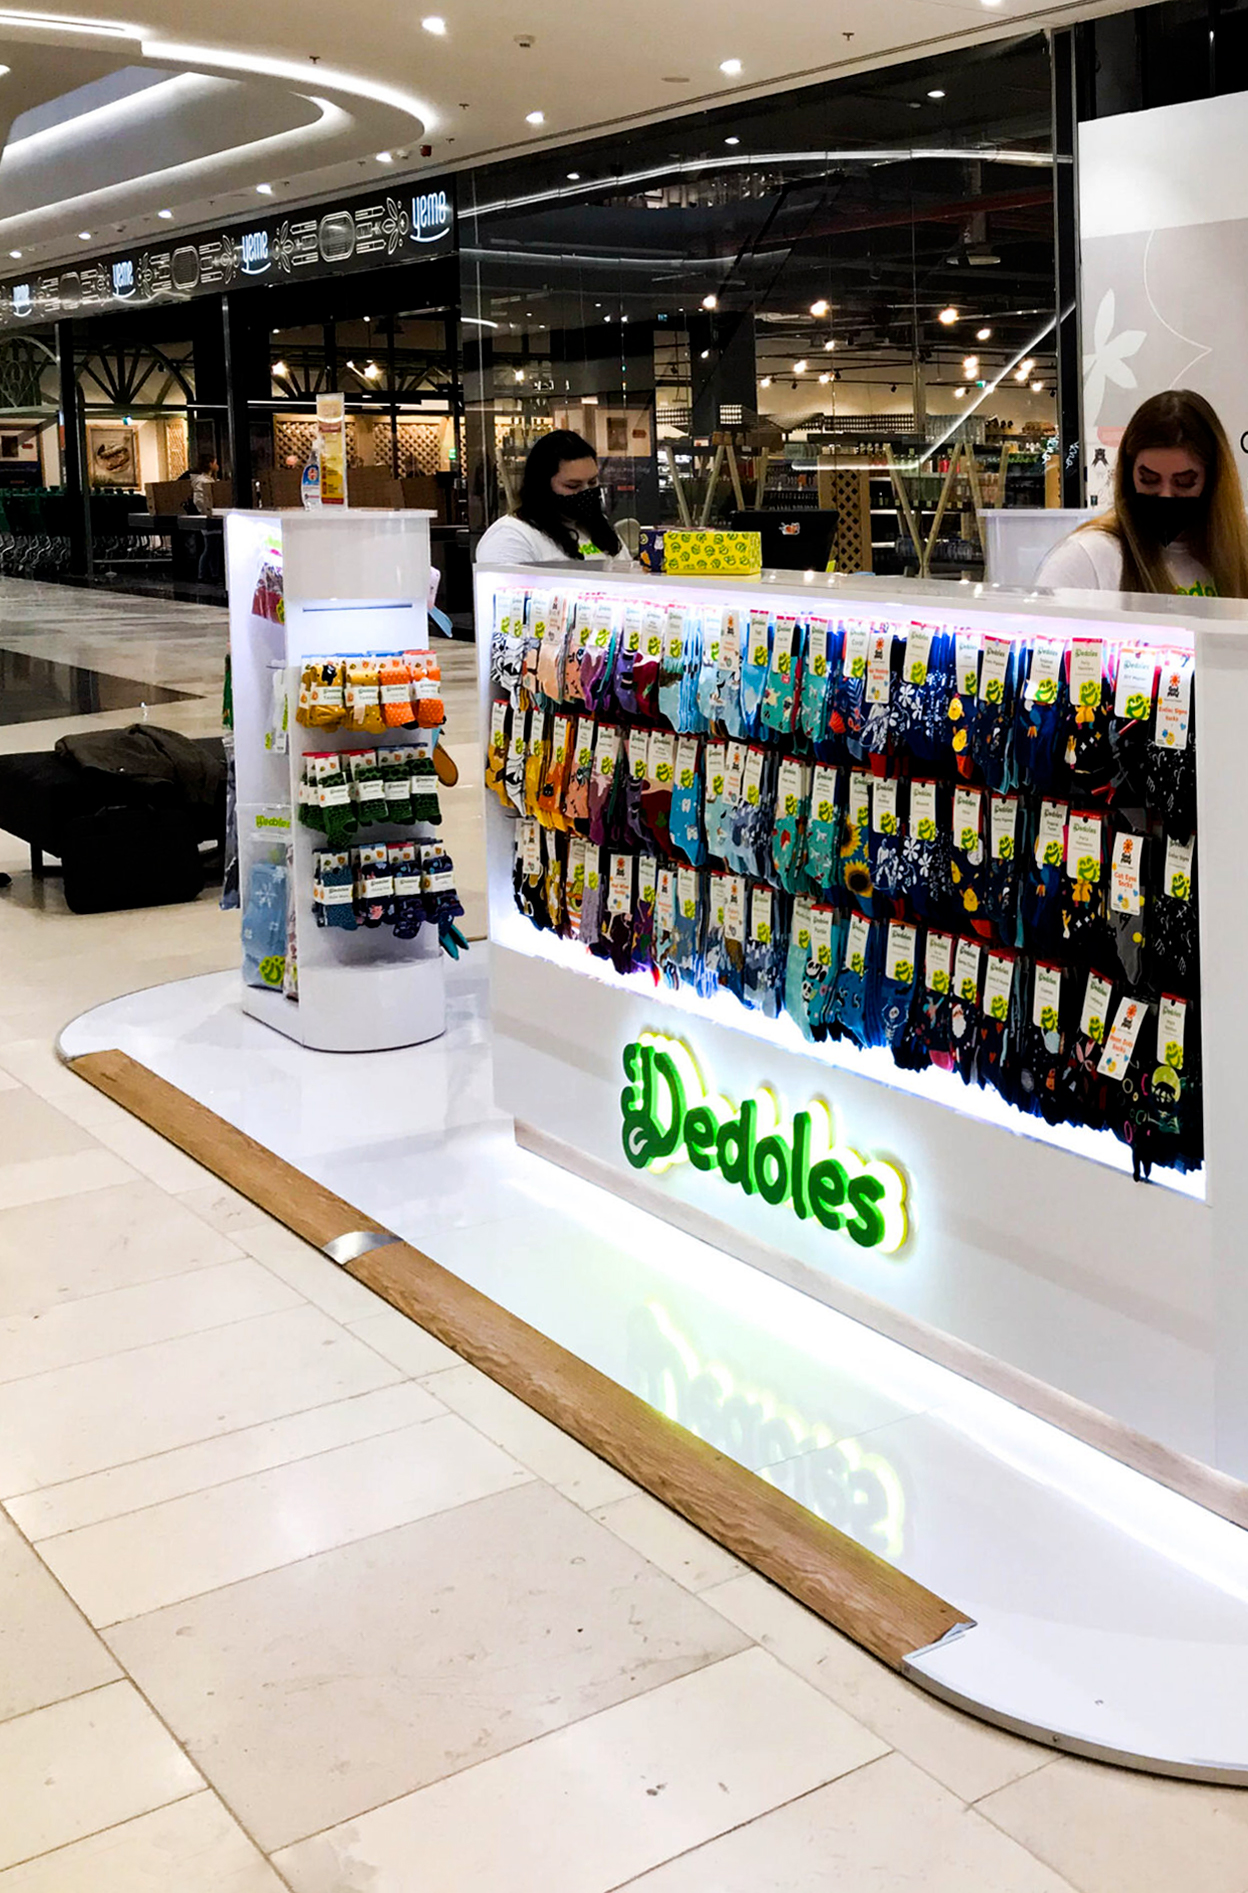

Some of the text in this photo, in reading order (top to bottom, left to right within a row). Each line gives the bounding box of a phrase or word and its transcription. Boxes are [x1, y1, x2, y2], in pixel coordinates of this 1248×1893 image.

[410, 191, 450, 243] yeme
[241, 230, 272, 275] yeme
[620, 1041, 887, 1248] Dedoles
